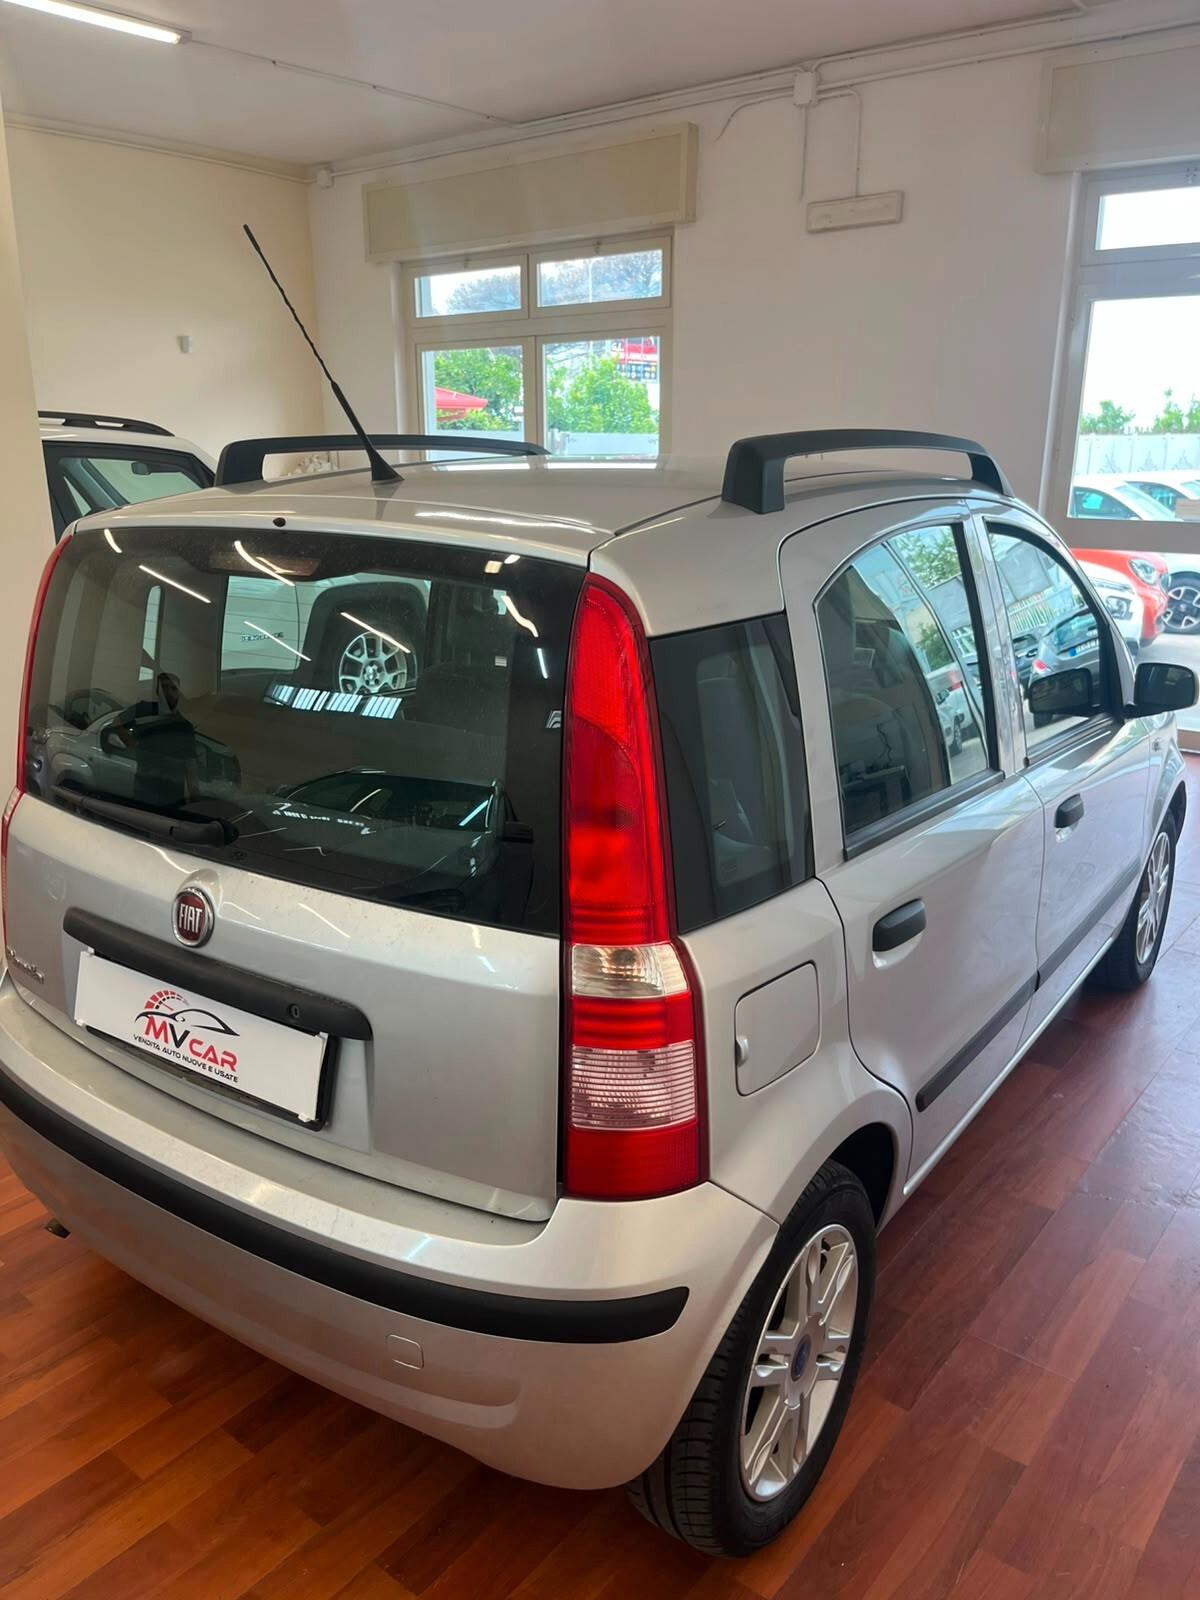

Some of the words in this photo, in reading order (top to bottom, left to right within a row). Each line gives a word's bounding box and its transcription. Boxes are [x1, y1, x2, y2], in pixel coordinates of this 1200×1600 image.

[179, 903, 202, 934] FIAT
[133, 1034, 160, 1051] VENDITA
[162, 1046, 181, 1060] AUTO
[182, 1054, 207, 1070] NUOVE
[207, 1064, 214, 1073] E
[214, 1066, 239, 1083] USATE
